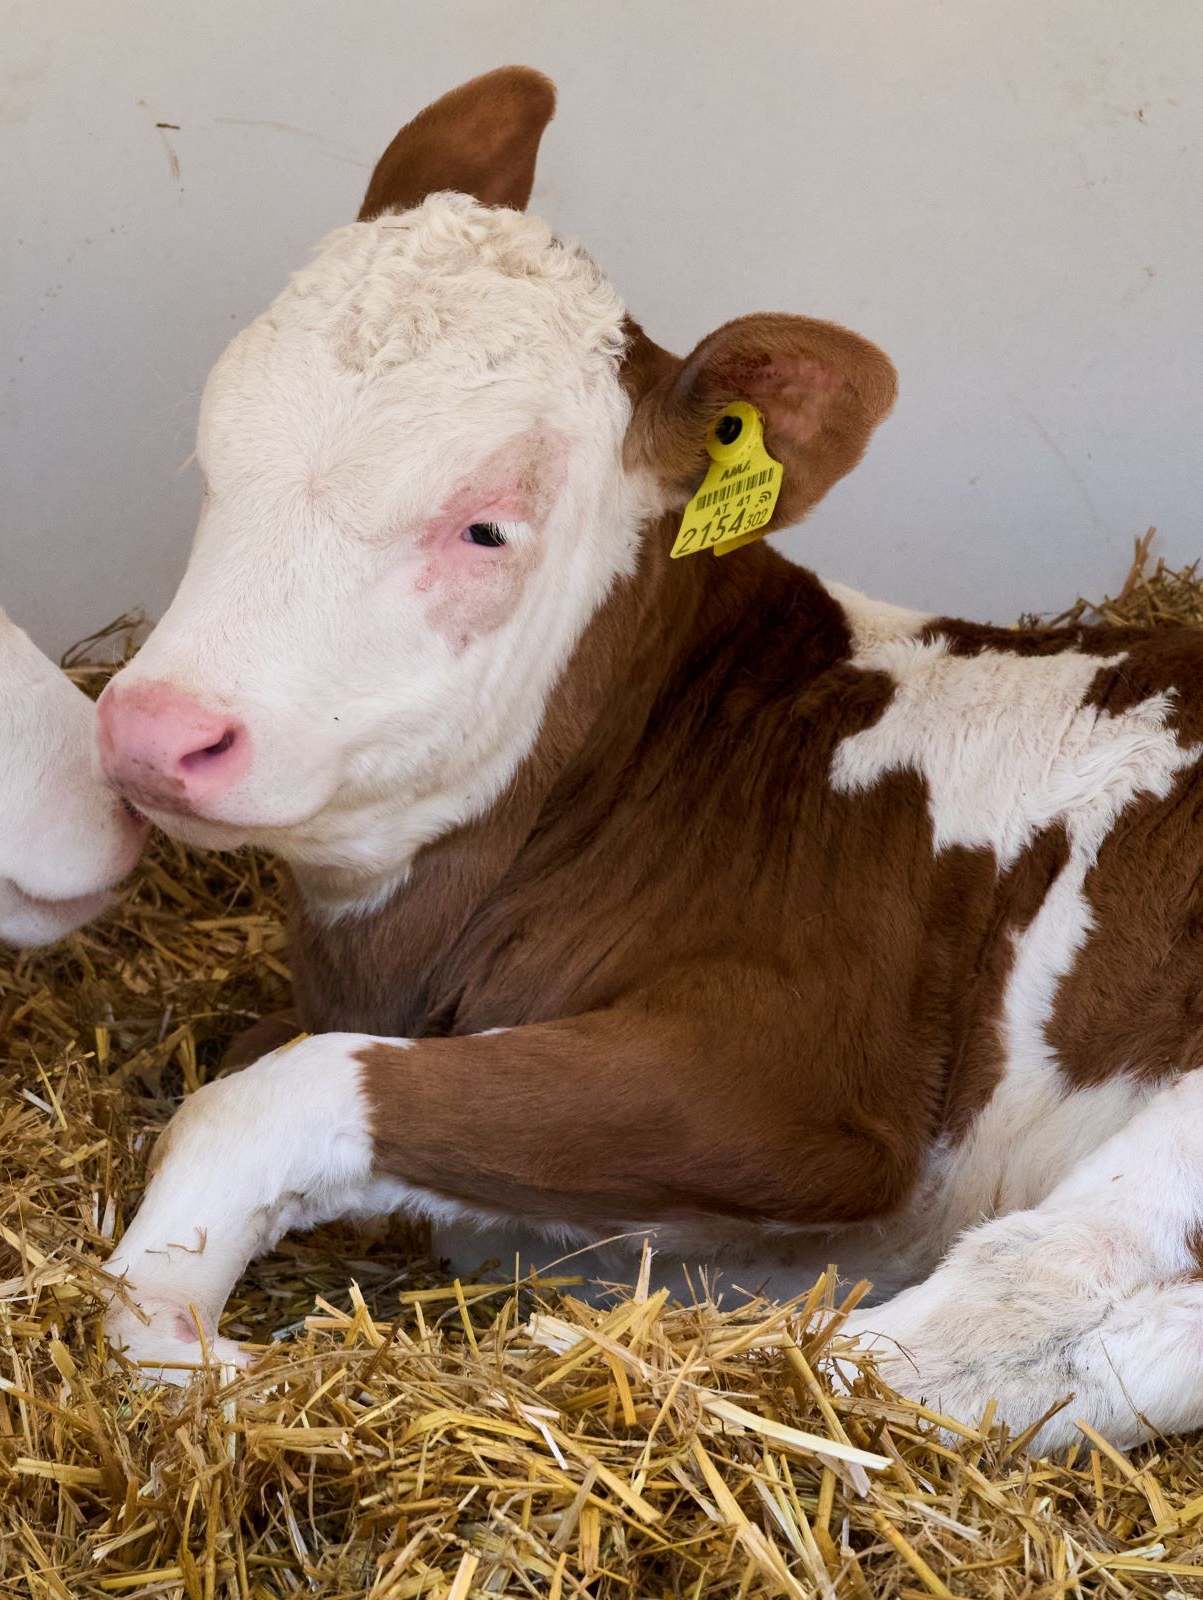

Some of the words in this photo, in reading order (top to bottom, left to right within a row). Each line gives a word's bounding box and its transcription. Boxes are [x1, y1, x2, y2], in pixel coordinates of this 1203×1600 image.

[713, 503, 730, 518] AT
[675, 508, 745, 555] 2154
[743, 508, 769, 531] 302
